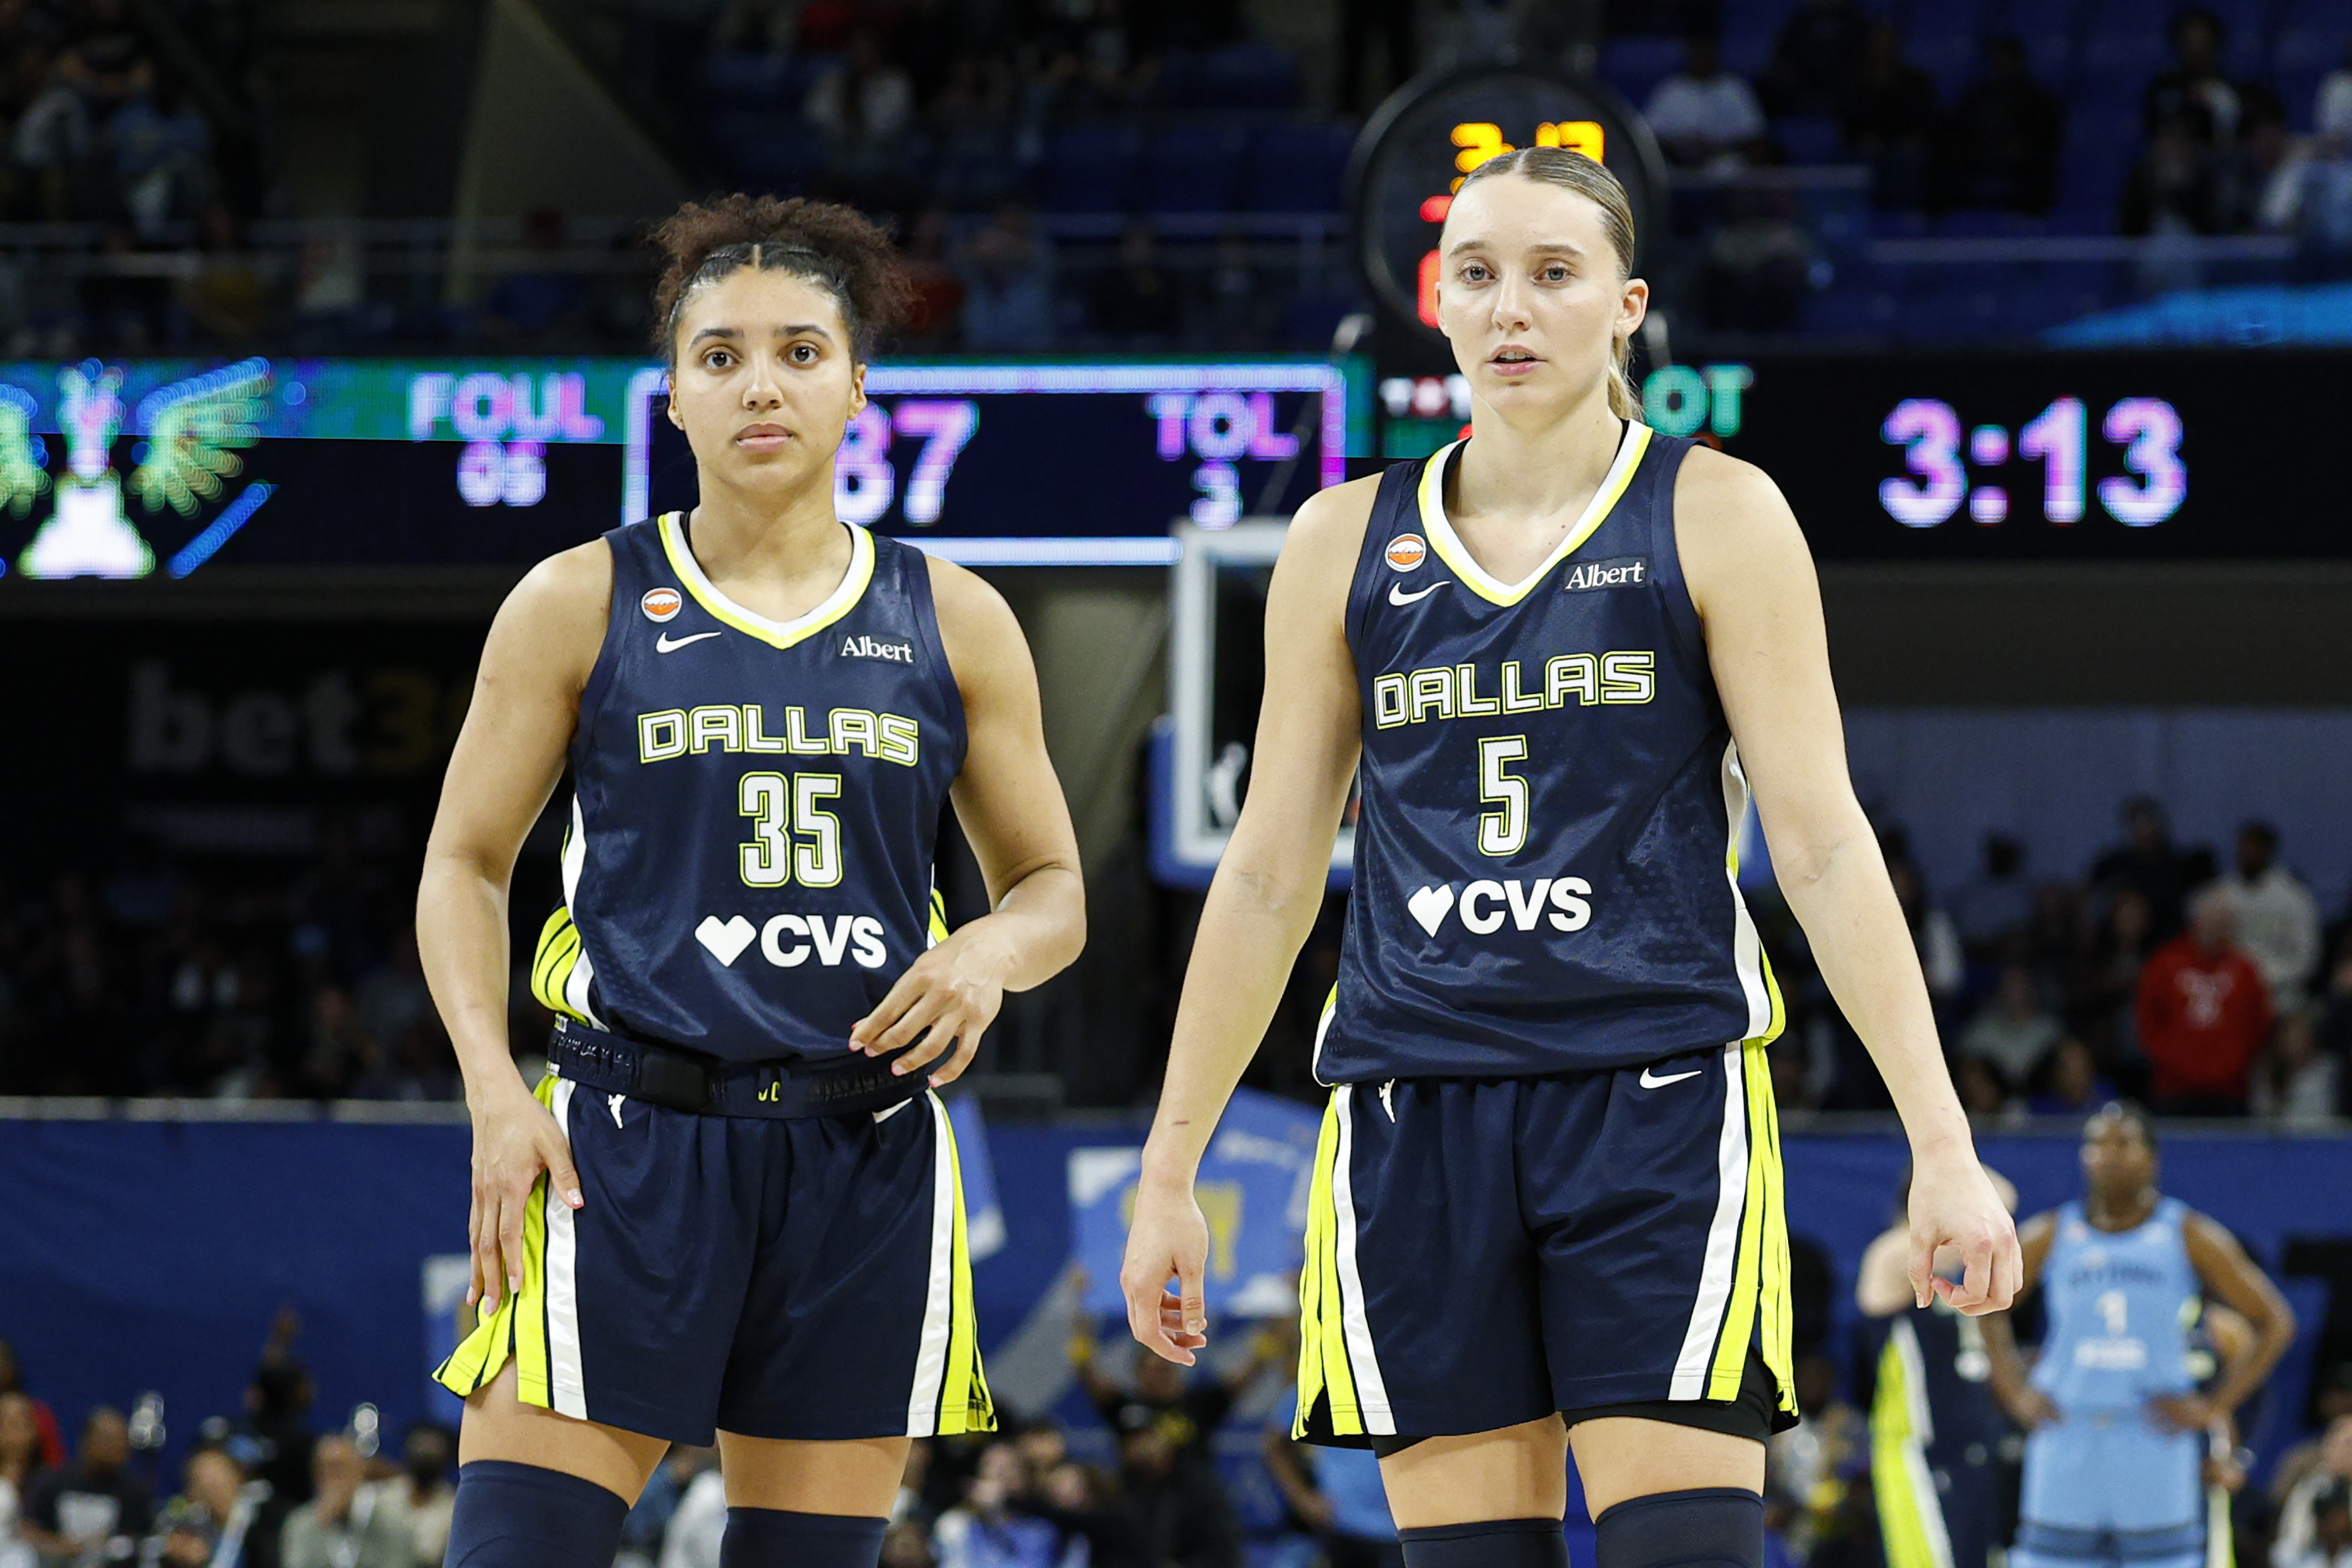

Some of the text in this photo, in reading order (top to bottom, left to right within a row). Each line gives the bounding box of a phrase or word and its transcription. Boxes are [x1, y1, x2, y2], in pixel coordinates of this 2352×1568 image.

[408, 372, 604, 442] FOUL
[1146, 391, 1300, 461] TOL
[1642, 364, 1754, 438] OT
[834, 399, 979, 527] 87
[1880, 396, 2188, 528] 3:13
[1565, 561, 1645, 590] Albert
[840, 636, 914, 663] Albert
[130, 656, 475, 775] bet3
[1374, 651, 1655, 730] DALLAS
[638, 704, 919, 767] DALLAS
[739, 771, 843, 887] 35
[1478, 734, 1529, 856] 5
[1459, 877, 1593, 935] CVS
[760, 914, 887, 969] CVS
[2096, 1287, 2127, 1334] 1
